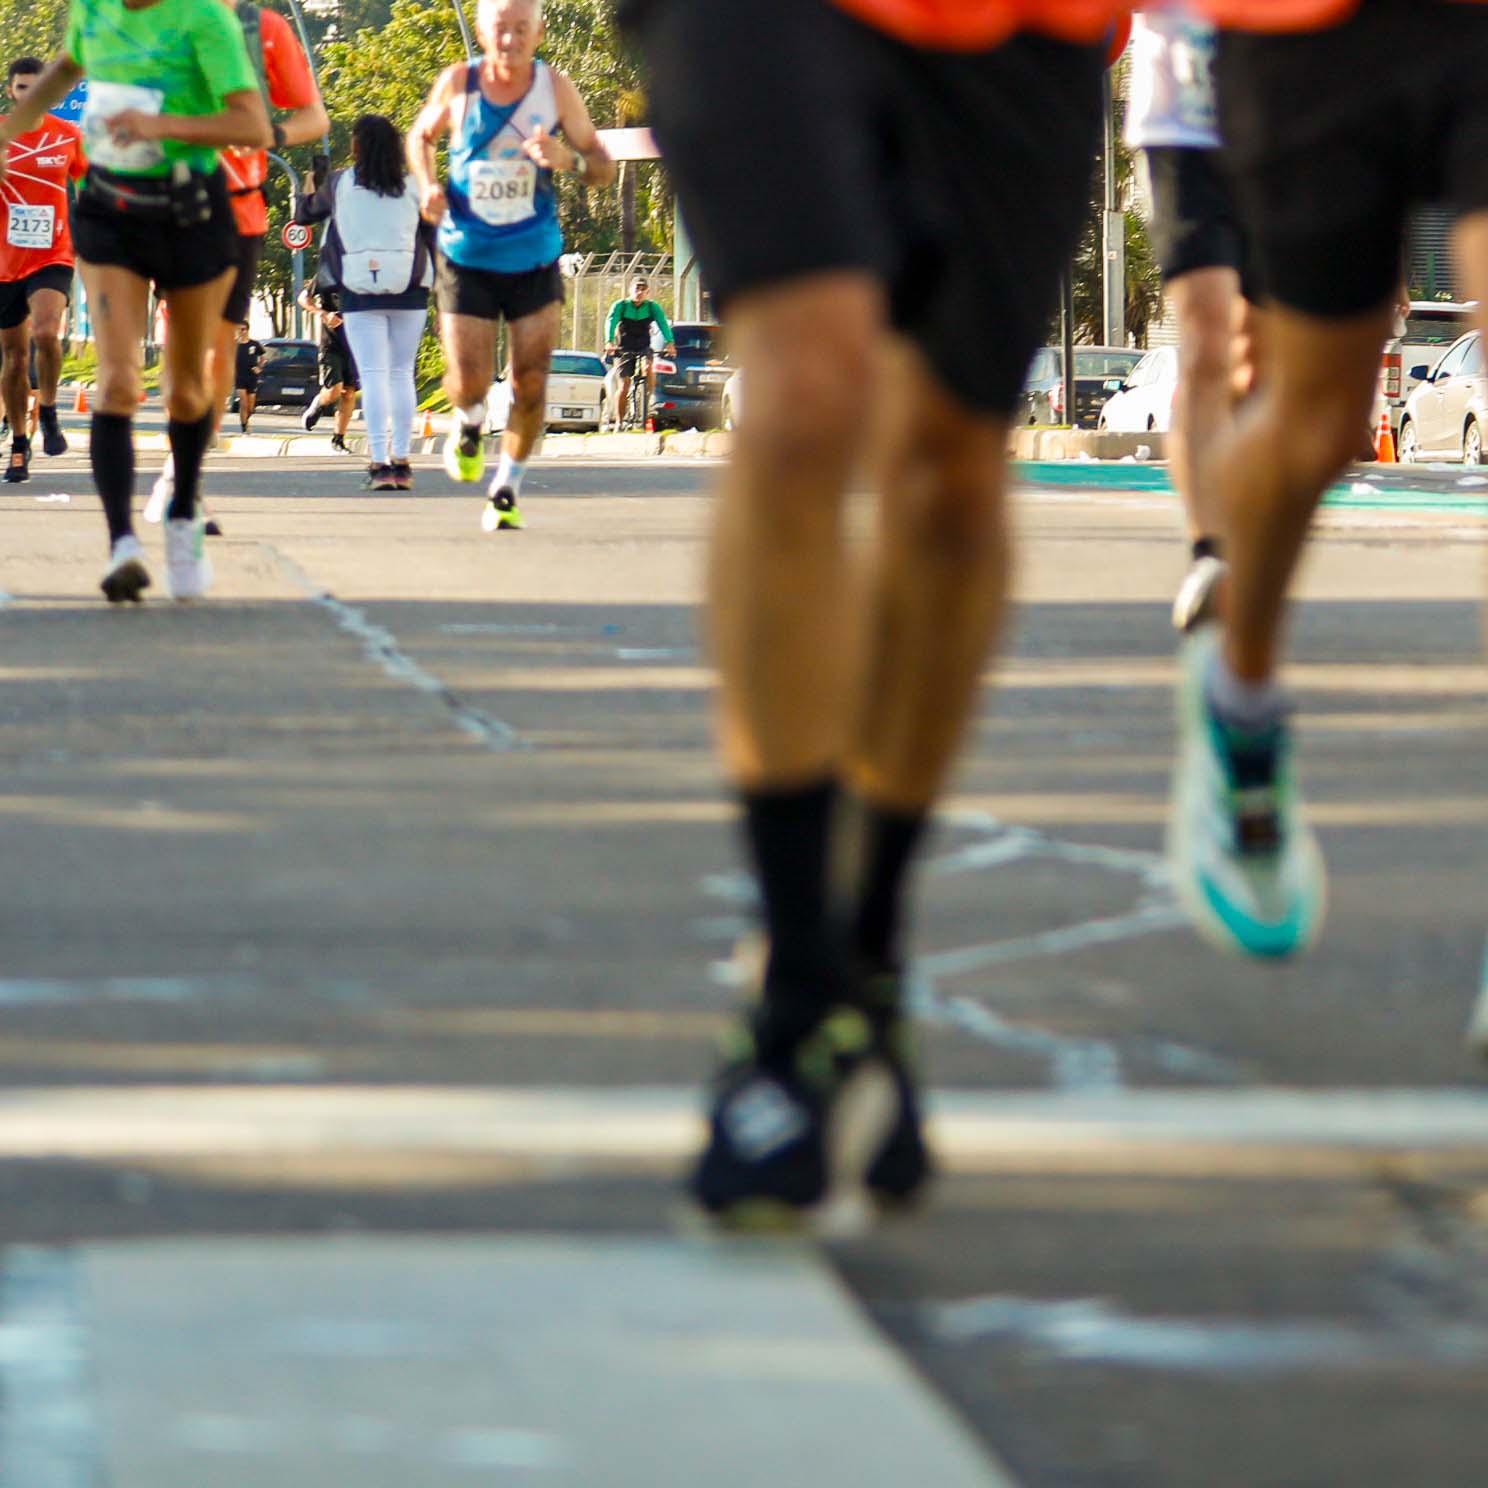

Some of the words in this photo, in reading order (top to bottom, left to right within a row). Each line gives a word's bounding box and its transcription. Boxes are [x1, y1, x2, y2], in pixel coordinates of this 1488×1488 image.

[475, 180, 529, 200] 2081
[10, 217, 51, 233] 2173
[288, 228, 306, 241] 60
